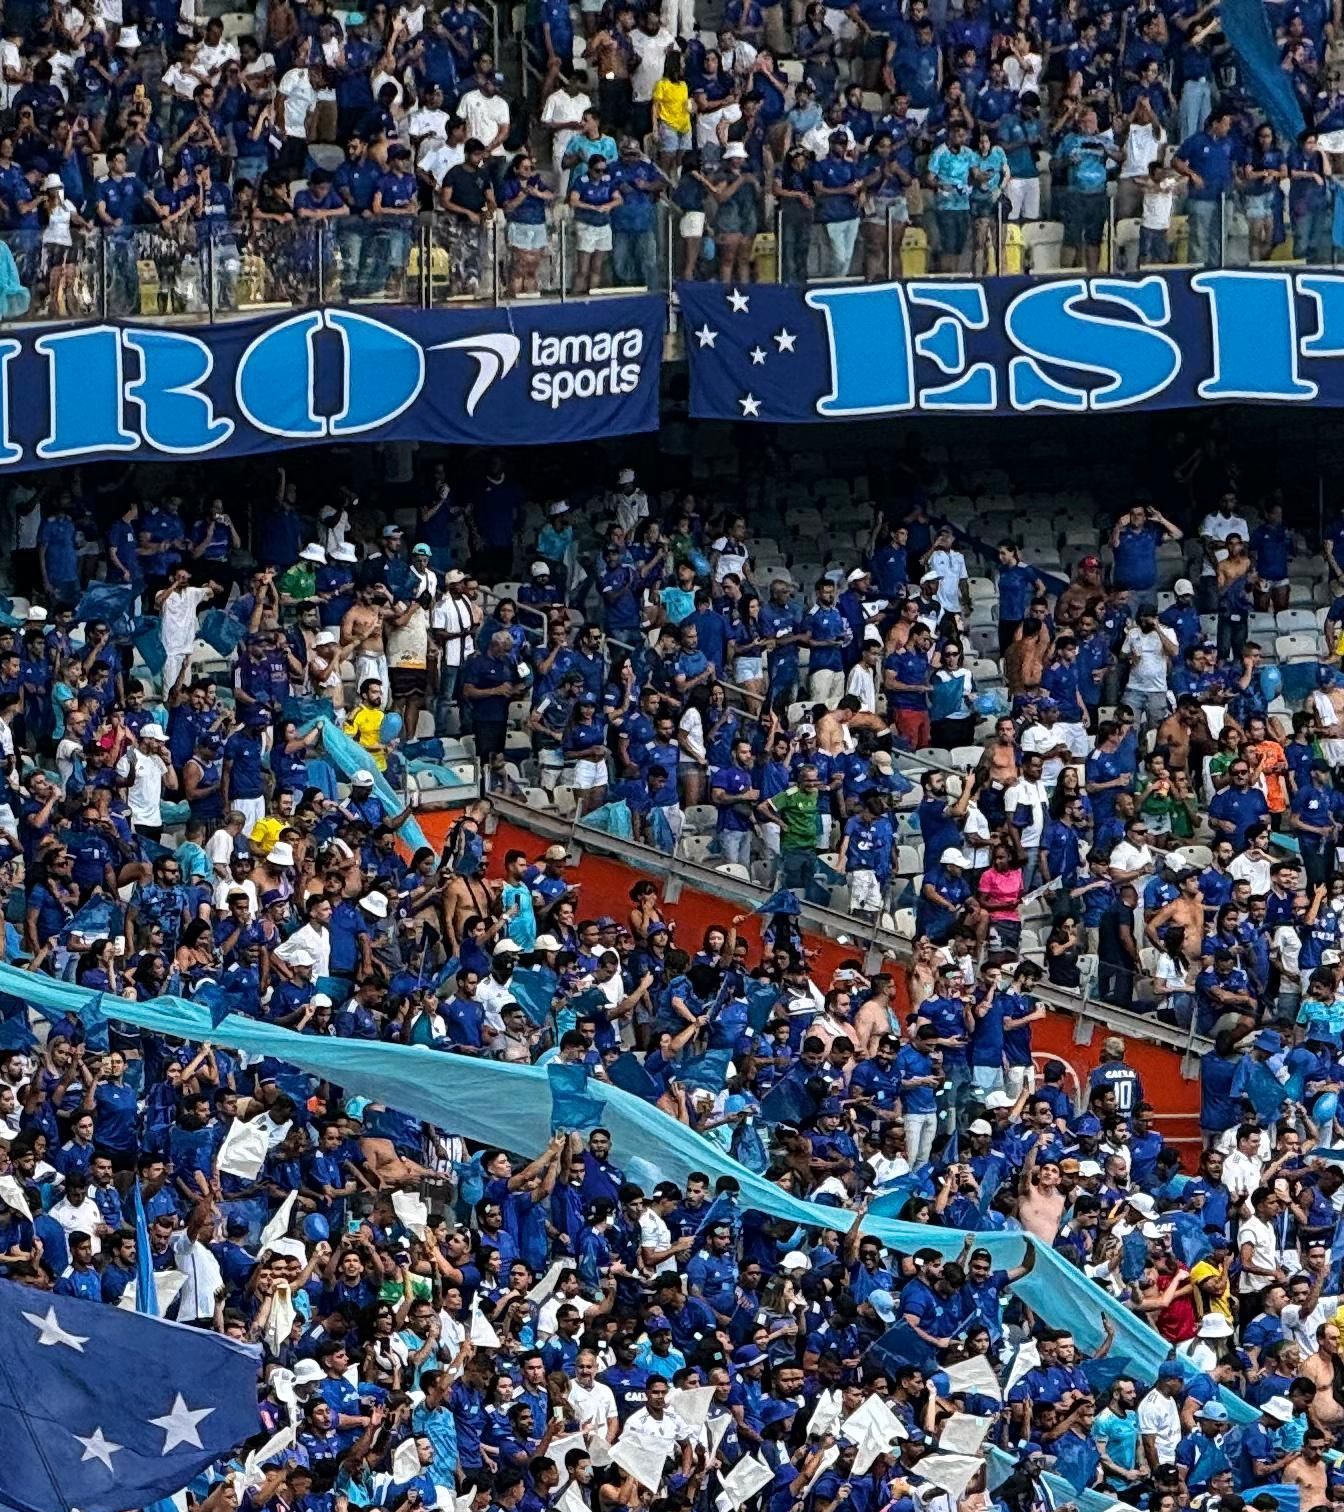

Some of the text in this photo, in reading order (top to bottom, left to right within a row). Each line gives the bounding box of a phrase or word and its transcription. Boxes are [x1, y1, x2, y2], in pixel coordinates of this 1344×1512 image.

[532, 328, 643, 366] tamara
[805, 271, 1344, 417] ESP
[530, 360, 640, 409] sports
